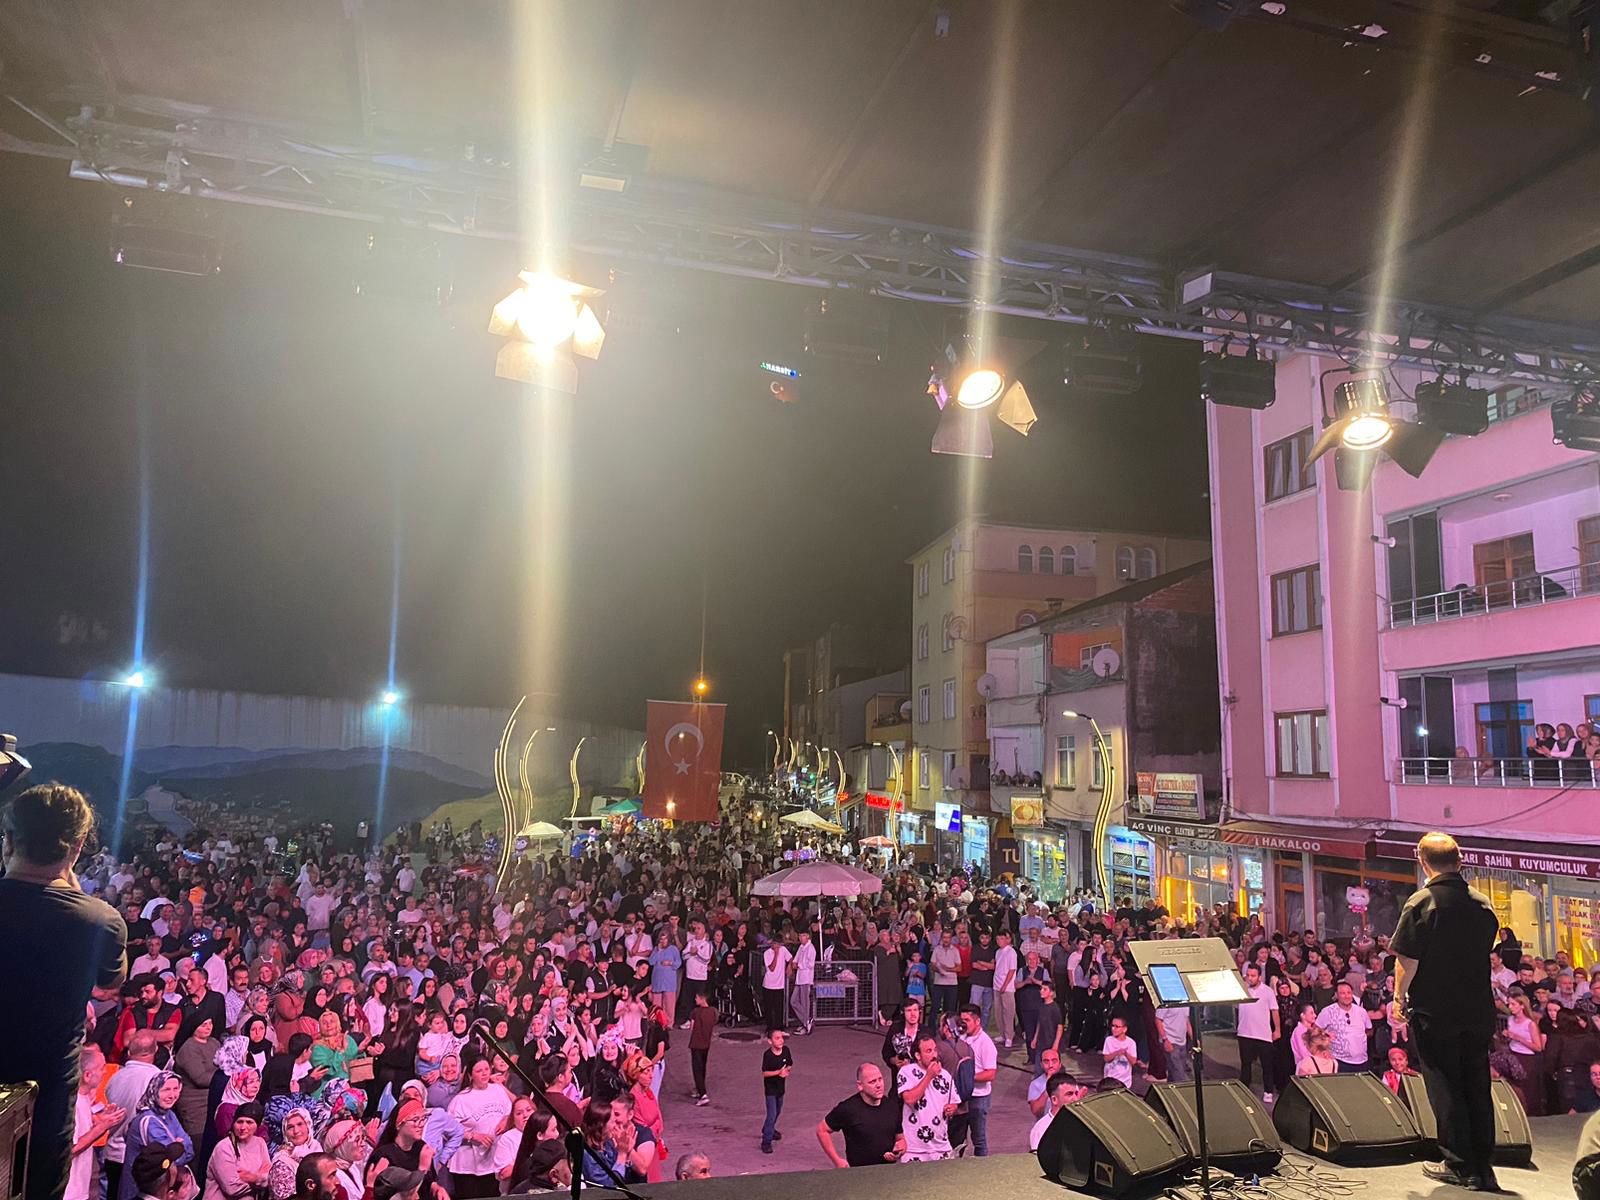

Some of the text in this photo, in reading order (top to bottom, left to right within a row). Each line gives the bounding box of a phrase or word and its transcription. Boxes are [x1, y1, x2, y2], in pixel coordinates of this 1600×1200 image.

[1132, 822, 1145, 830] AG
[1262, 837, 1320, 852] HAKALOO
[1484, 854, 1512, 868] ŞAHİN
[1519, 858, 1587, 875] KUYUMCULUK
